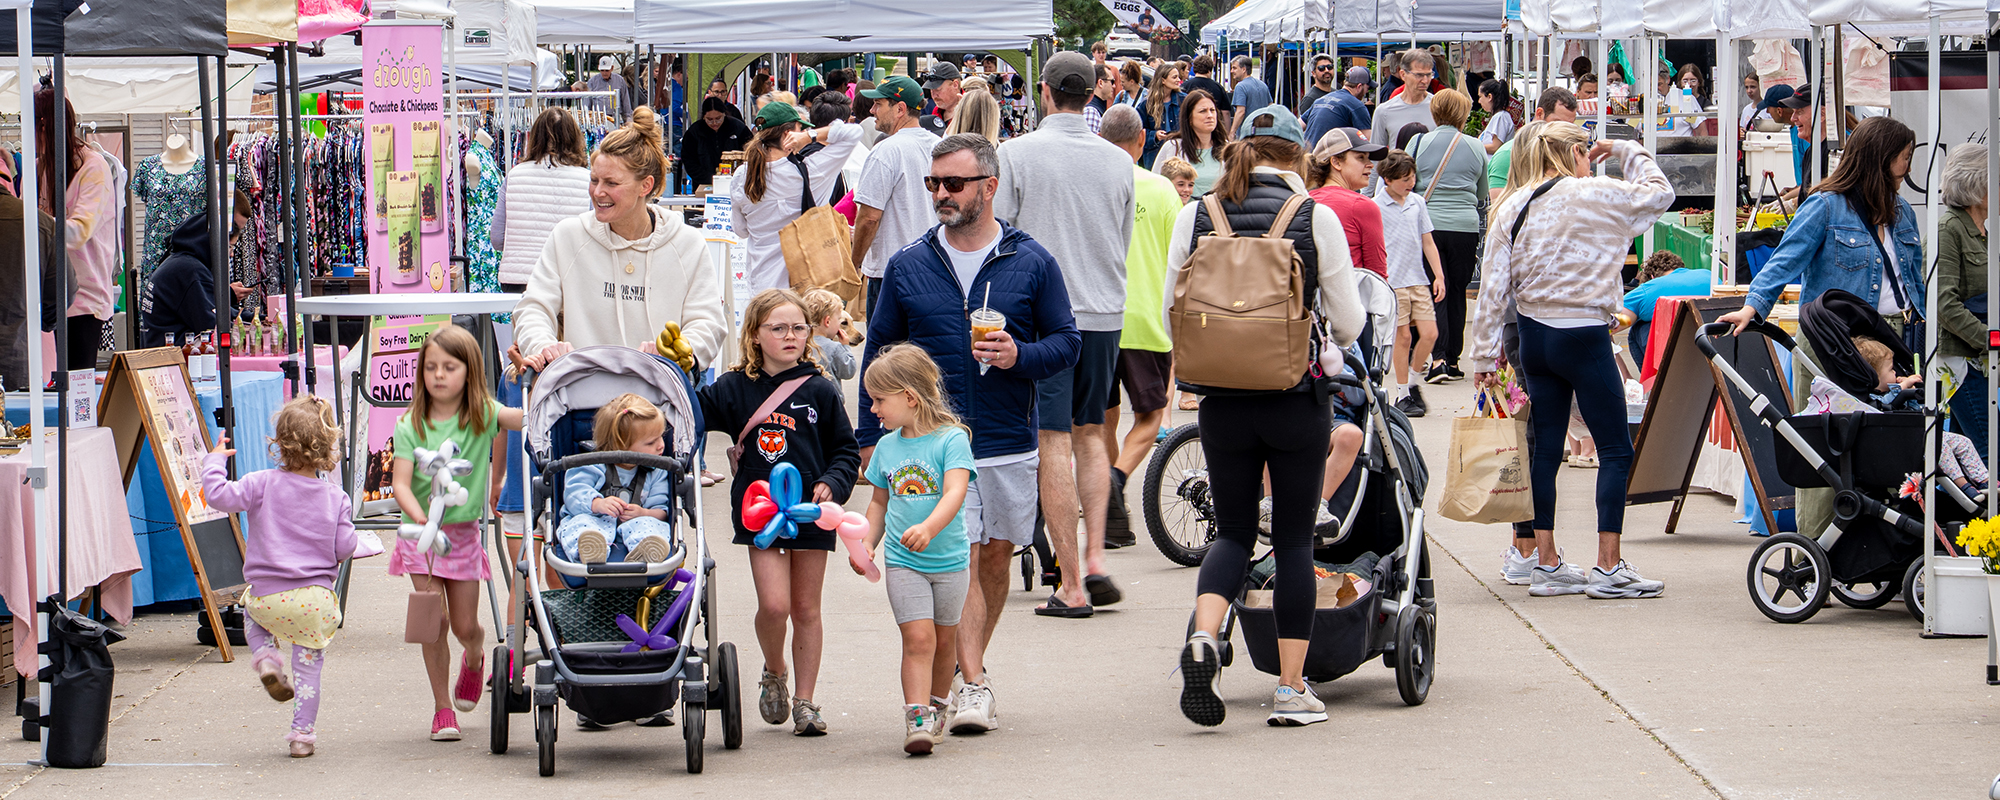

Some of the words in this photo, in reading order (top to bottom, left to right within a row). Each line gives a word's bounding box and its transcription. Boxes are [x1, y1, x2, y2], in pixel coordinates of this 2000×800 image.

[1113, 2, 1141, 13] EGGS
[373, 63, 432, 94] dzough
[369, 100, 399, 114] Chocolate
[400, 99, 406, 112] &
[406, 98, 438, 115] Chickpeas
[603, 281, 630, 295] TAYOR
[380, 336, 393, 348] Soy
[394, 335, 408, 345] Free
[409, 333, 424, 344] Dairy
[380, 359, 409, 380] Guilt
[70, 374, 86, 382] FOLLOW
[372, 382, 414, 402] SNAC
[1277, 688, 1292, 696] NIKE
